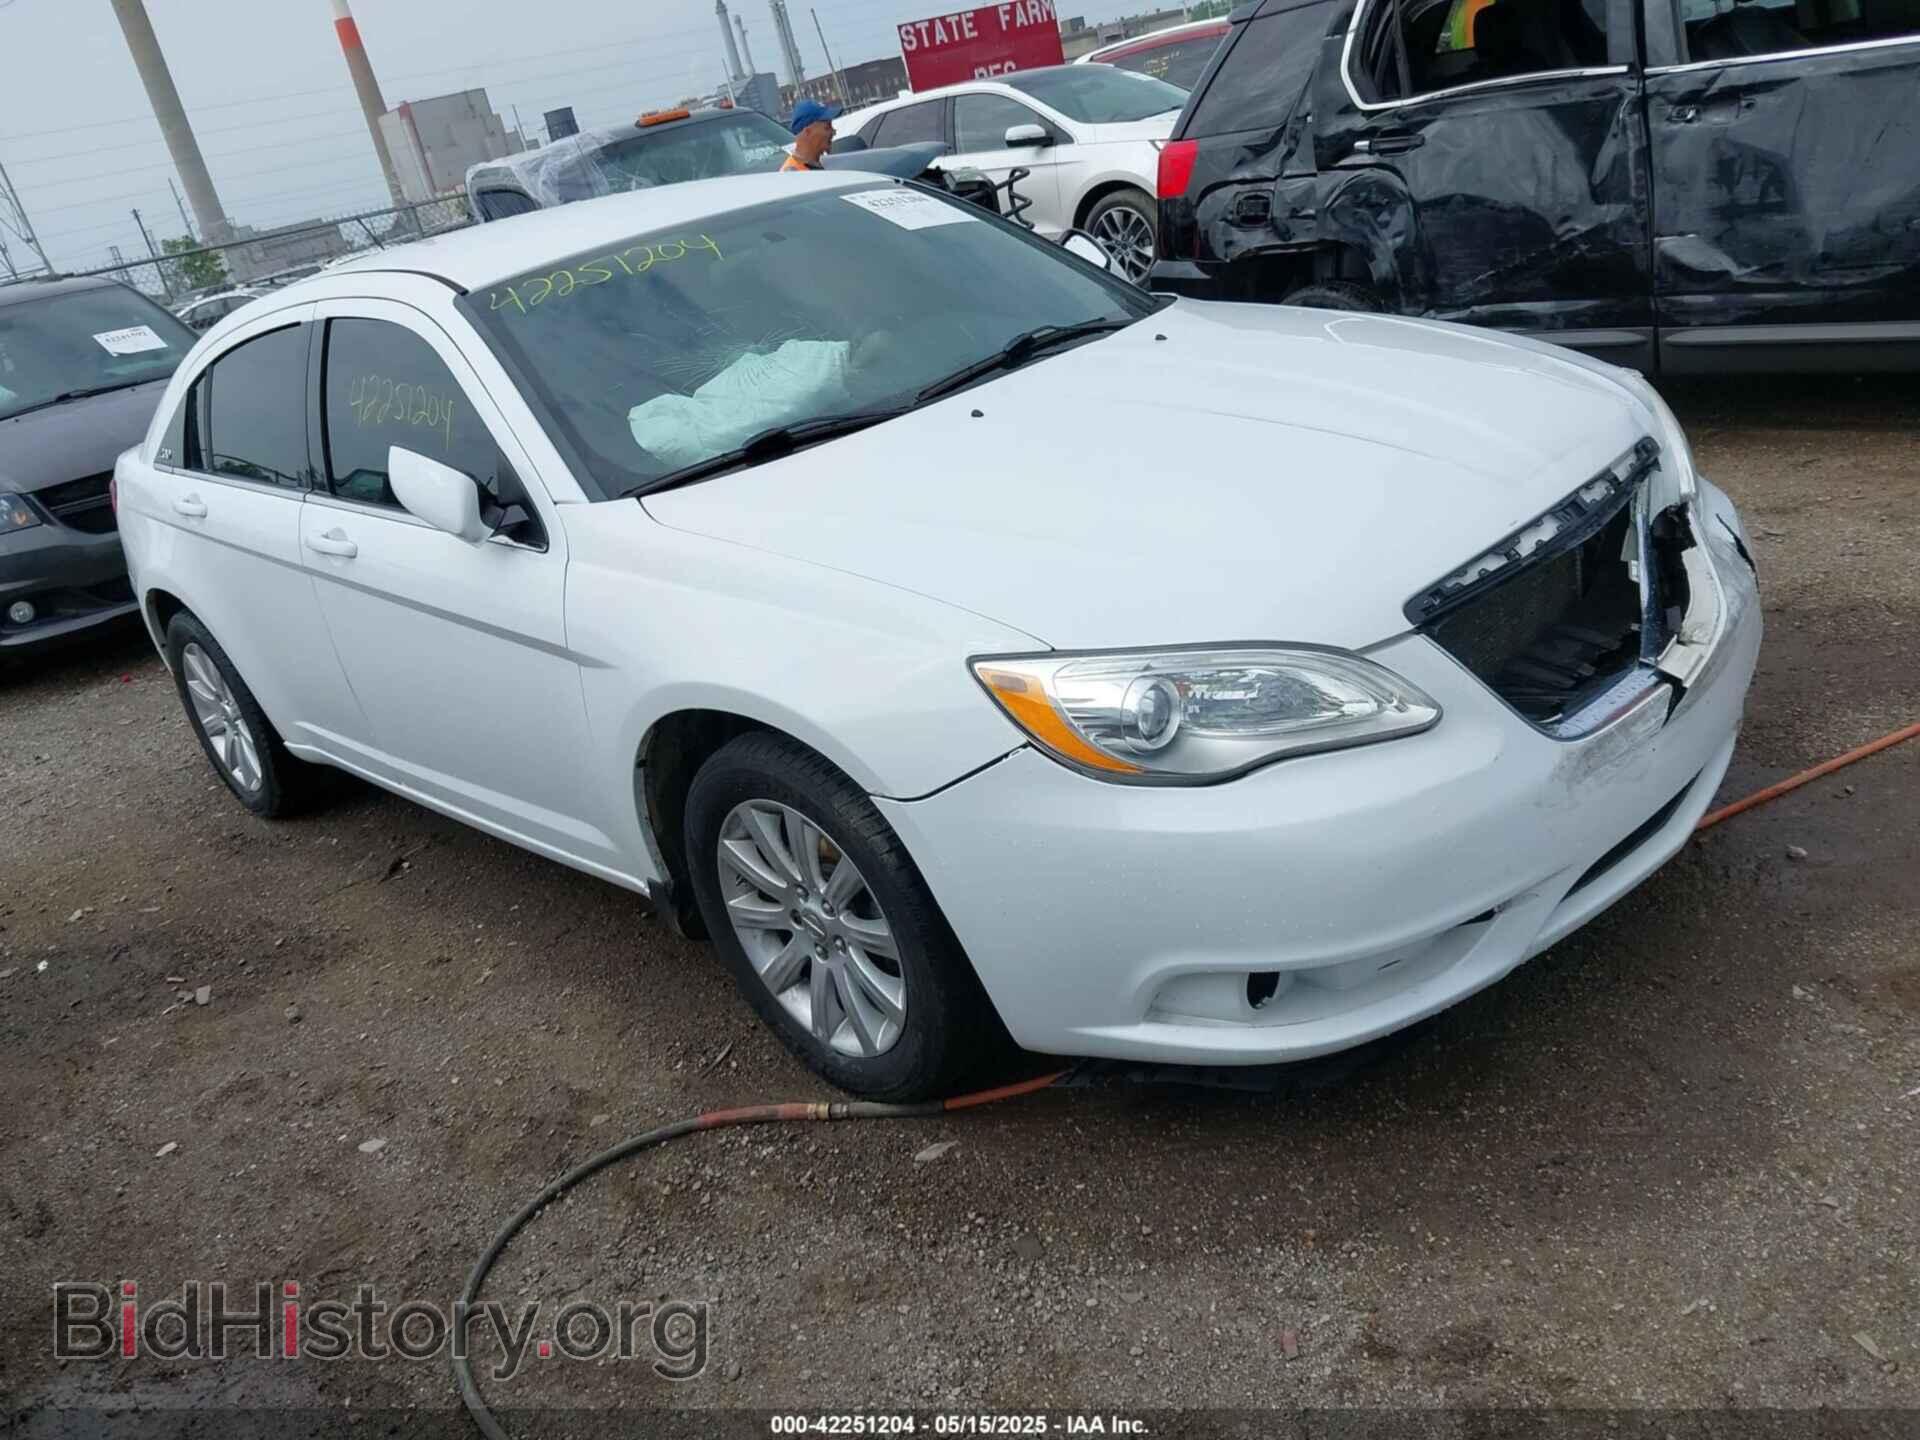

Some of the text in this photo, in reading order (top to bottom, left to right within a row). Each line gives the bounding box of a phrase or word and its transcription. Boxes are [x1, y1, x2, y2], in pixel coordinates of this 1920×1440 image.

[901, 0, 1056, 51] STATE FARM
[489, 233, 725, 314] 42251204
[350, 374, 454, 451] 42251204
